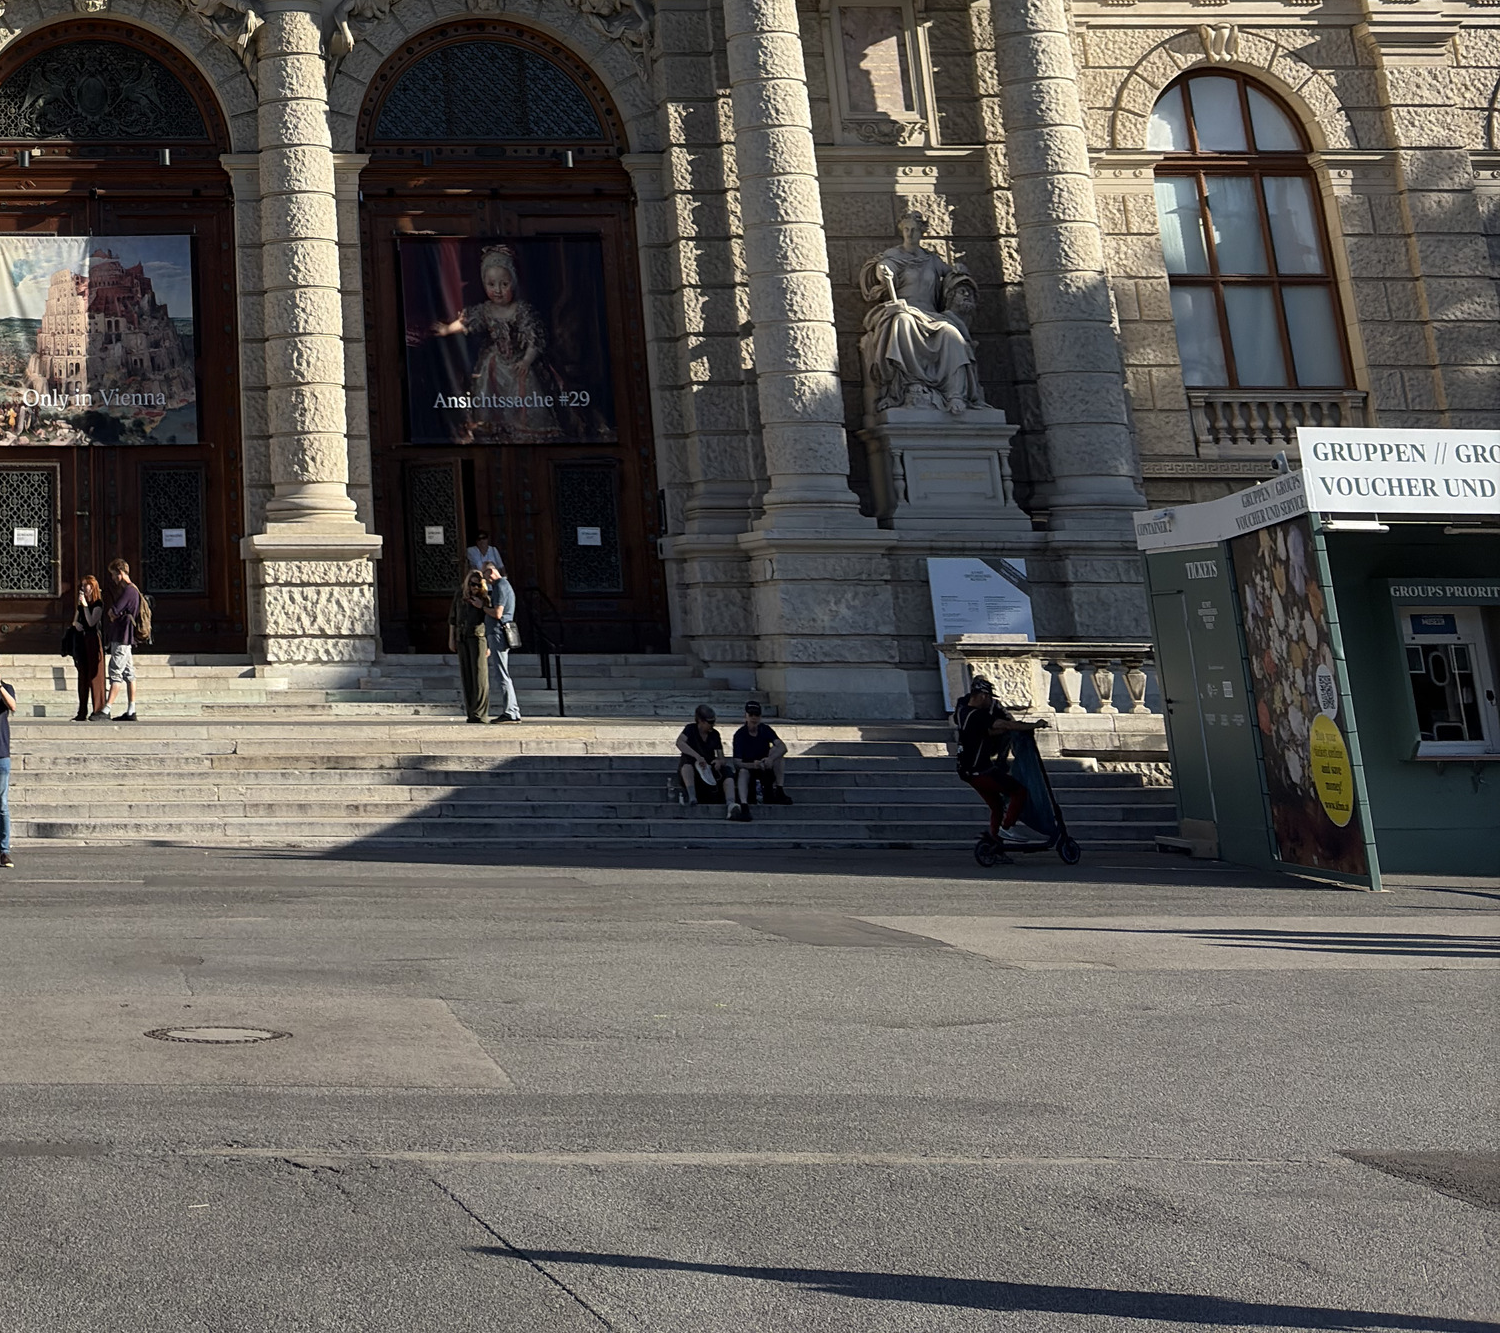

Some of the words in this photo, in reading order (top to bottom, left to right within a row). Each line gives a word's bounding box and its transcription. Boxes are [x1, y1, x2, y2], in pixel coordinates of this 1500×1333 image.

[23, 388, 69, 410] Only
[75, 388, 93, 406] in
[99, 389, 167, 406] Vienna
[433, 391, 554, 409] Ansichtssache
[558, 391, 591, 407] #29
[1312, 442, 1427, 463] GRUPPEN
[1241, 486, 1270, 508] GRUPPEN
[1276, 475, 1301, 497] GROUPS
[1318, 476, 1440, 497] VOUCHER
[1442, 478, 1496, 498] UND
[1235, 510, 1266, 532] VOUCHER
[1266, 505, 1281, 524] UND
[1280, 495, 1305, 519] SERVICE
[1136, 520, 1168, 536] CONTAINER
[1185, 560, 1218, 579] TICKETS
[1390, 585, 1443, 597] GROUPS
